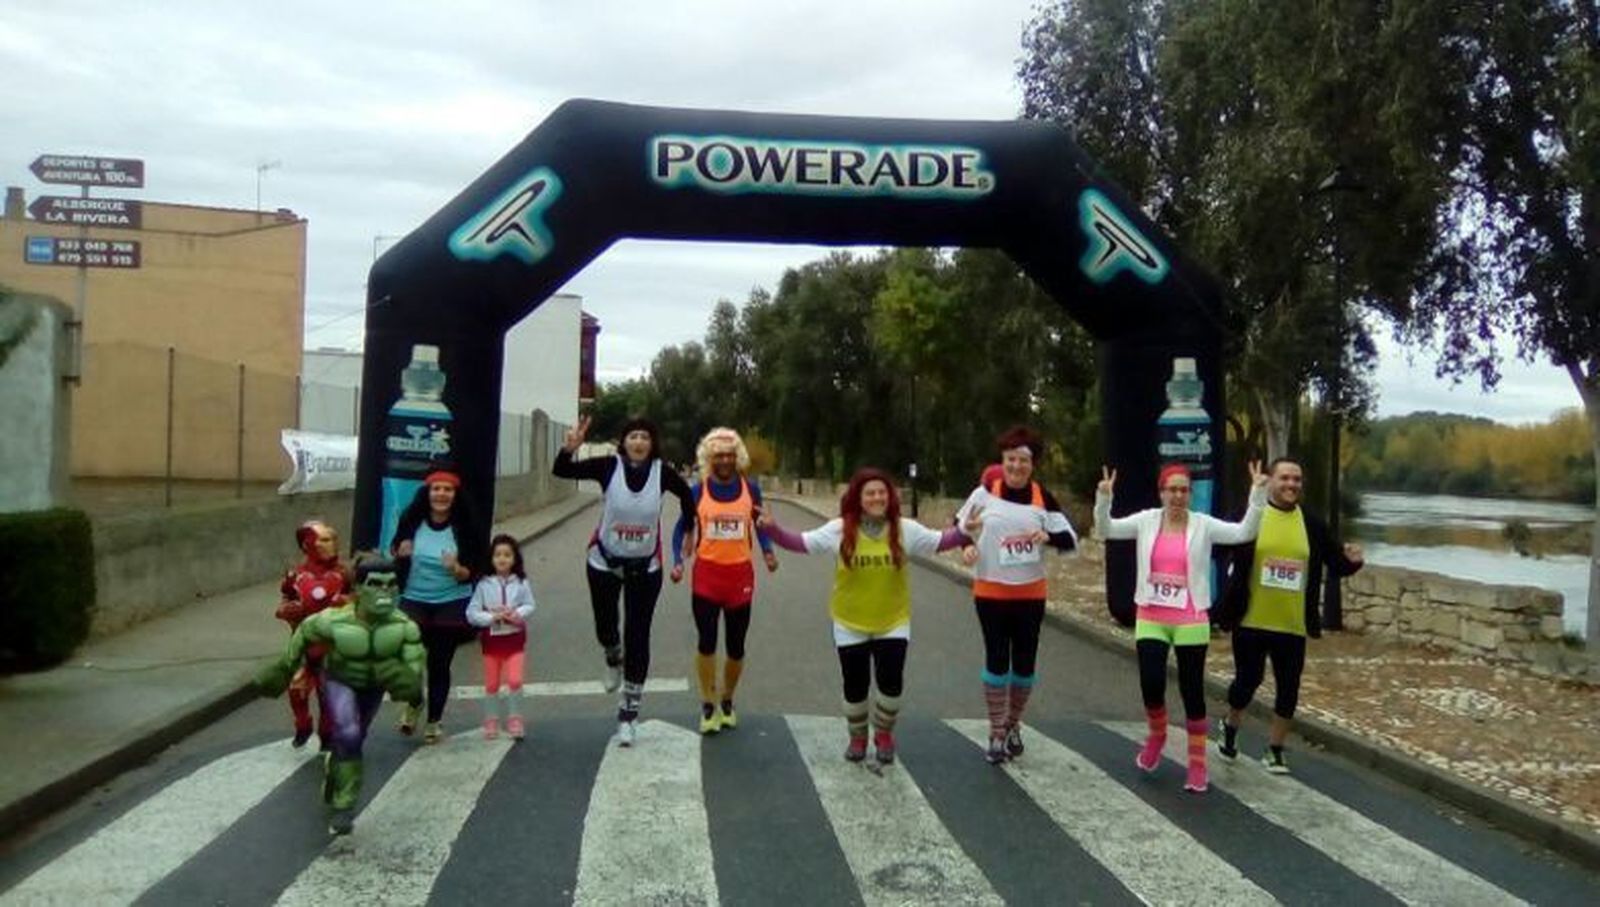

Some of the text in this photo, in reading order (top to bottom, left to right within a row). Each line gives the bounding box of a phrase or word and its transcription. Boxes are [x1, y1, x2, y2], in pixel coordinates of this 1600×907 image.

[42, 158, 96, 169] DEPORTES
[656, 141, 977, 190] POWERADE
[42, 170, 101, 182] AVENTURA
[52, 199, 127, 212] ALBERGUE
[45, 211, 130, 224] LA RIVERA
[617, 529, 645, 542] 185
[1154, 582, 1182, 598] 187
